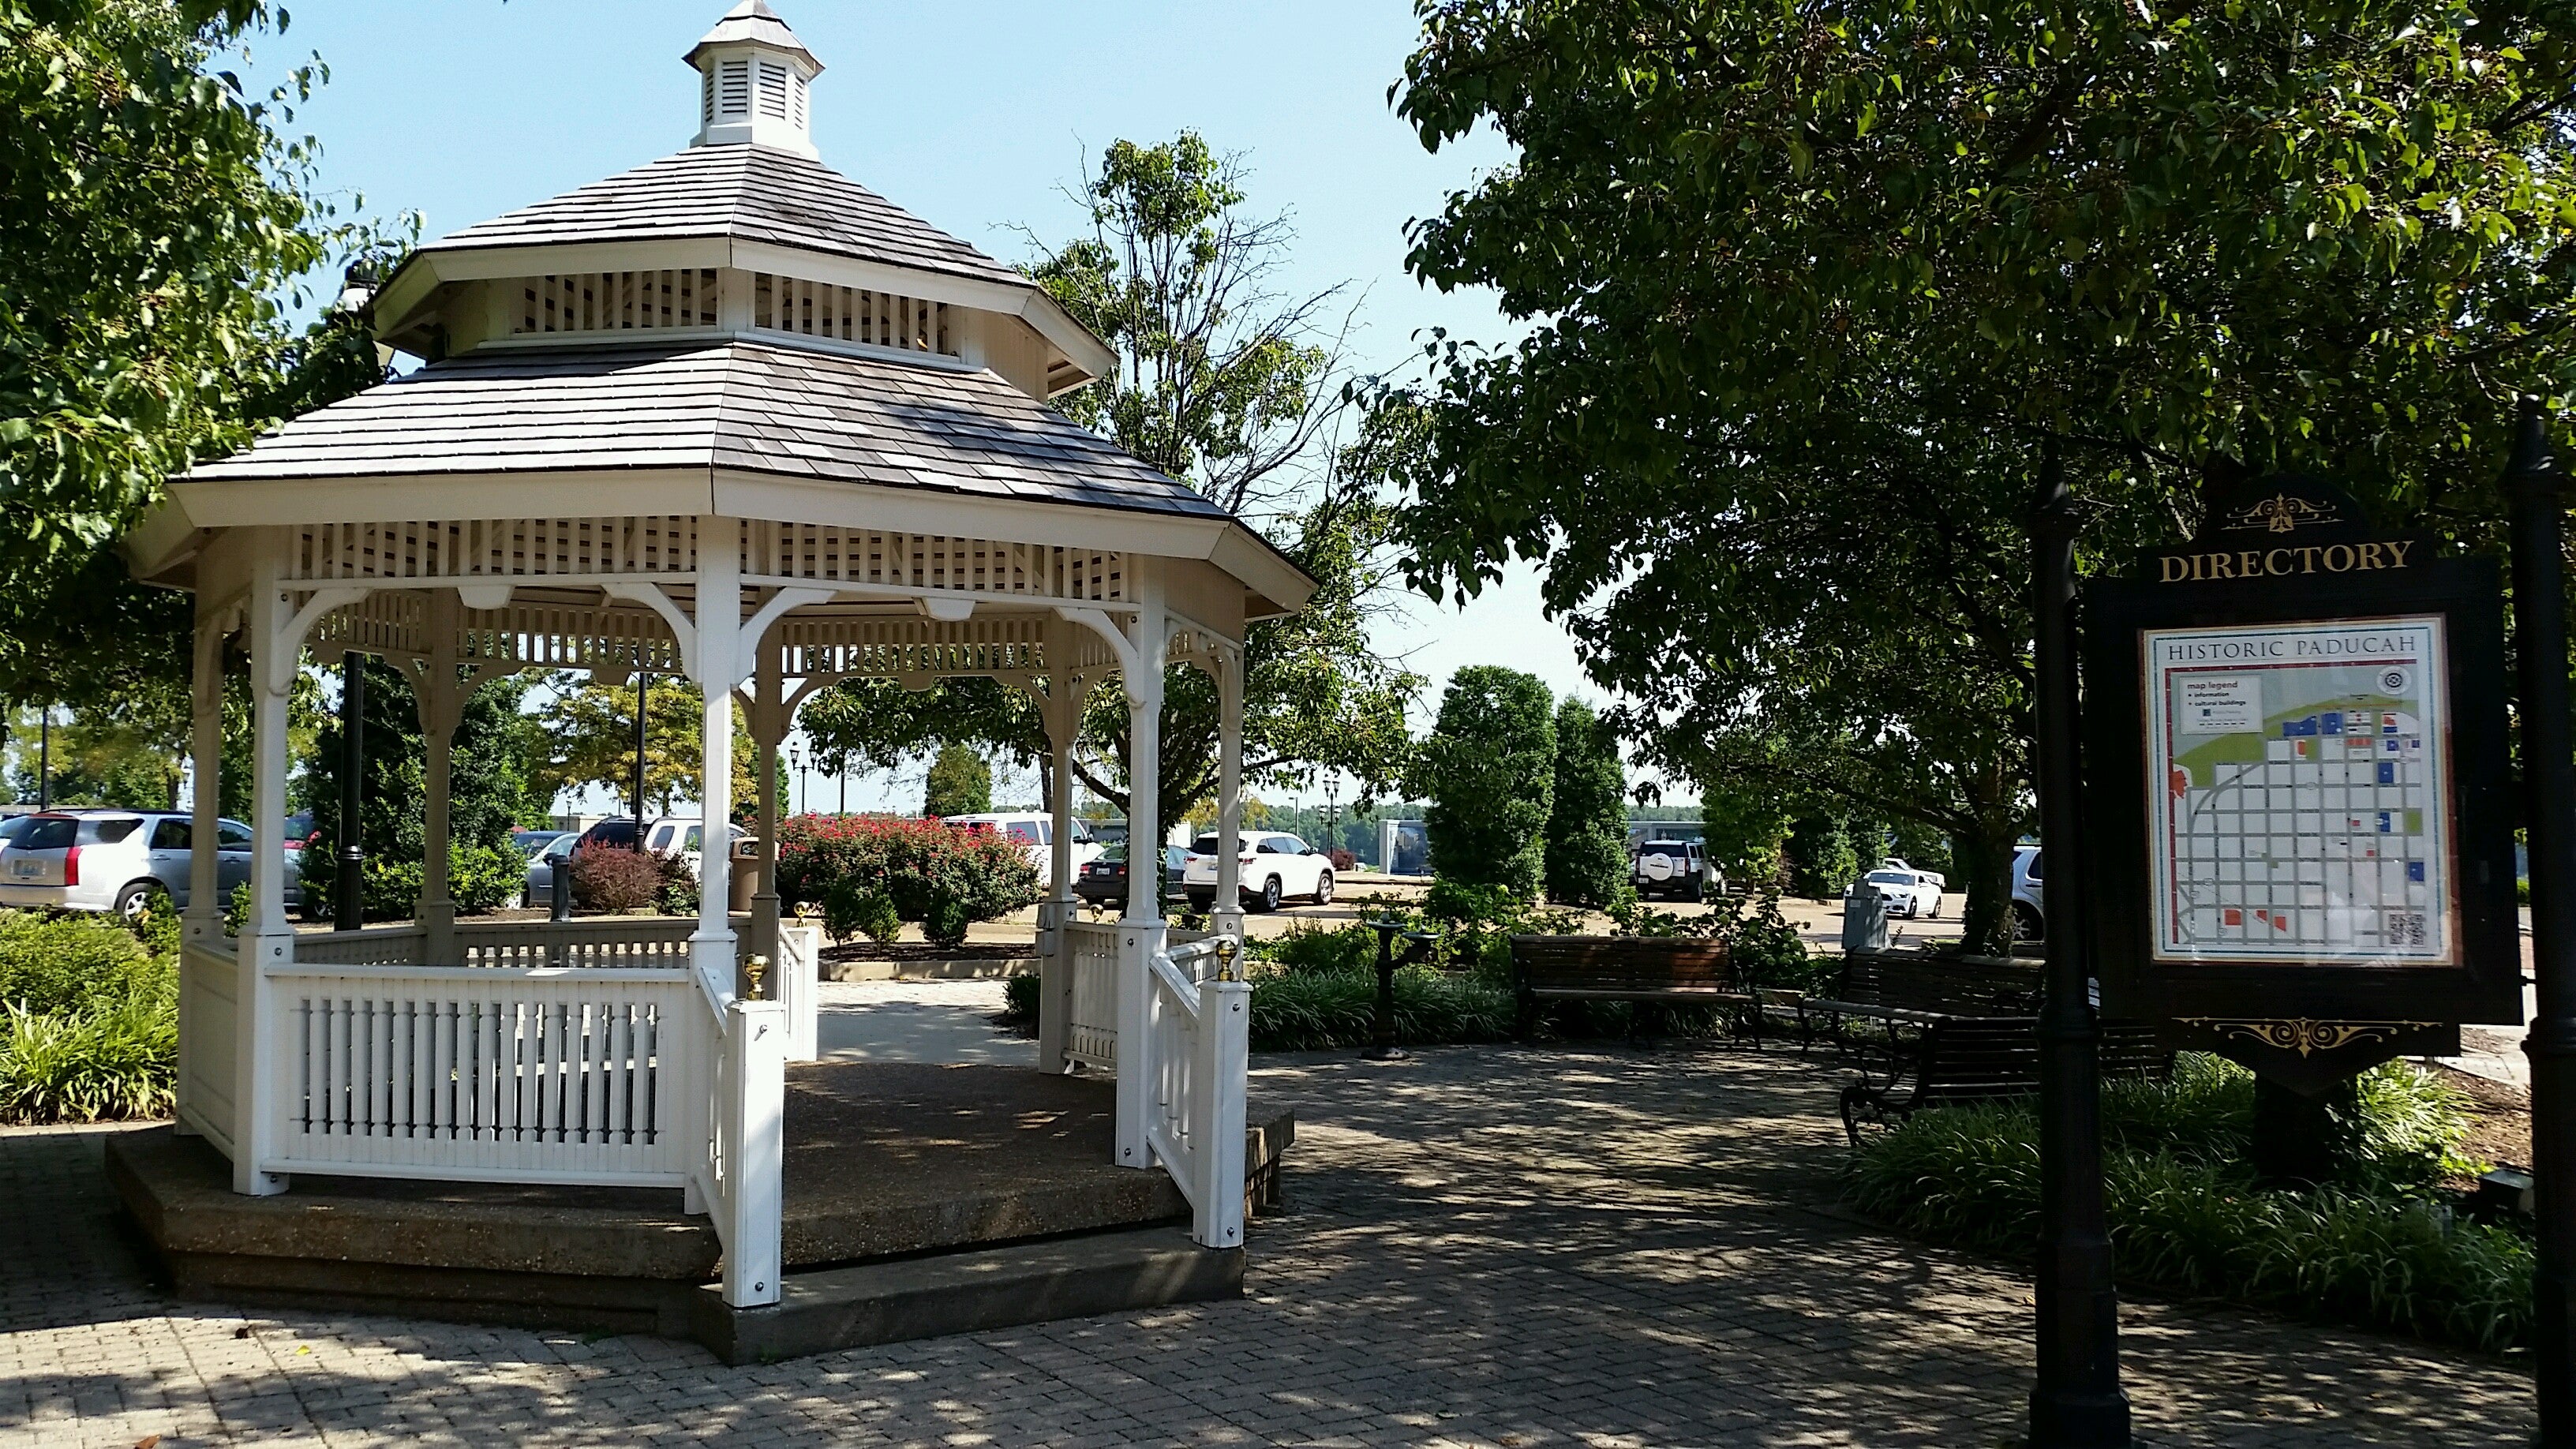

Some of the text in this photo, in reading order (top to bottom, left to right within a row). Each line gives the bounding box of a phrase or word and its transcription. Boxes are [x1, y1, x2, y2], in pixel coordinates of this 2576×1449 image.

[2159, 541, 2415, 582] DIRECTORY
[2169, 636, 2416, 661] HISTORIC PADUCAH
[2208, 680, 2238, 691] legend
